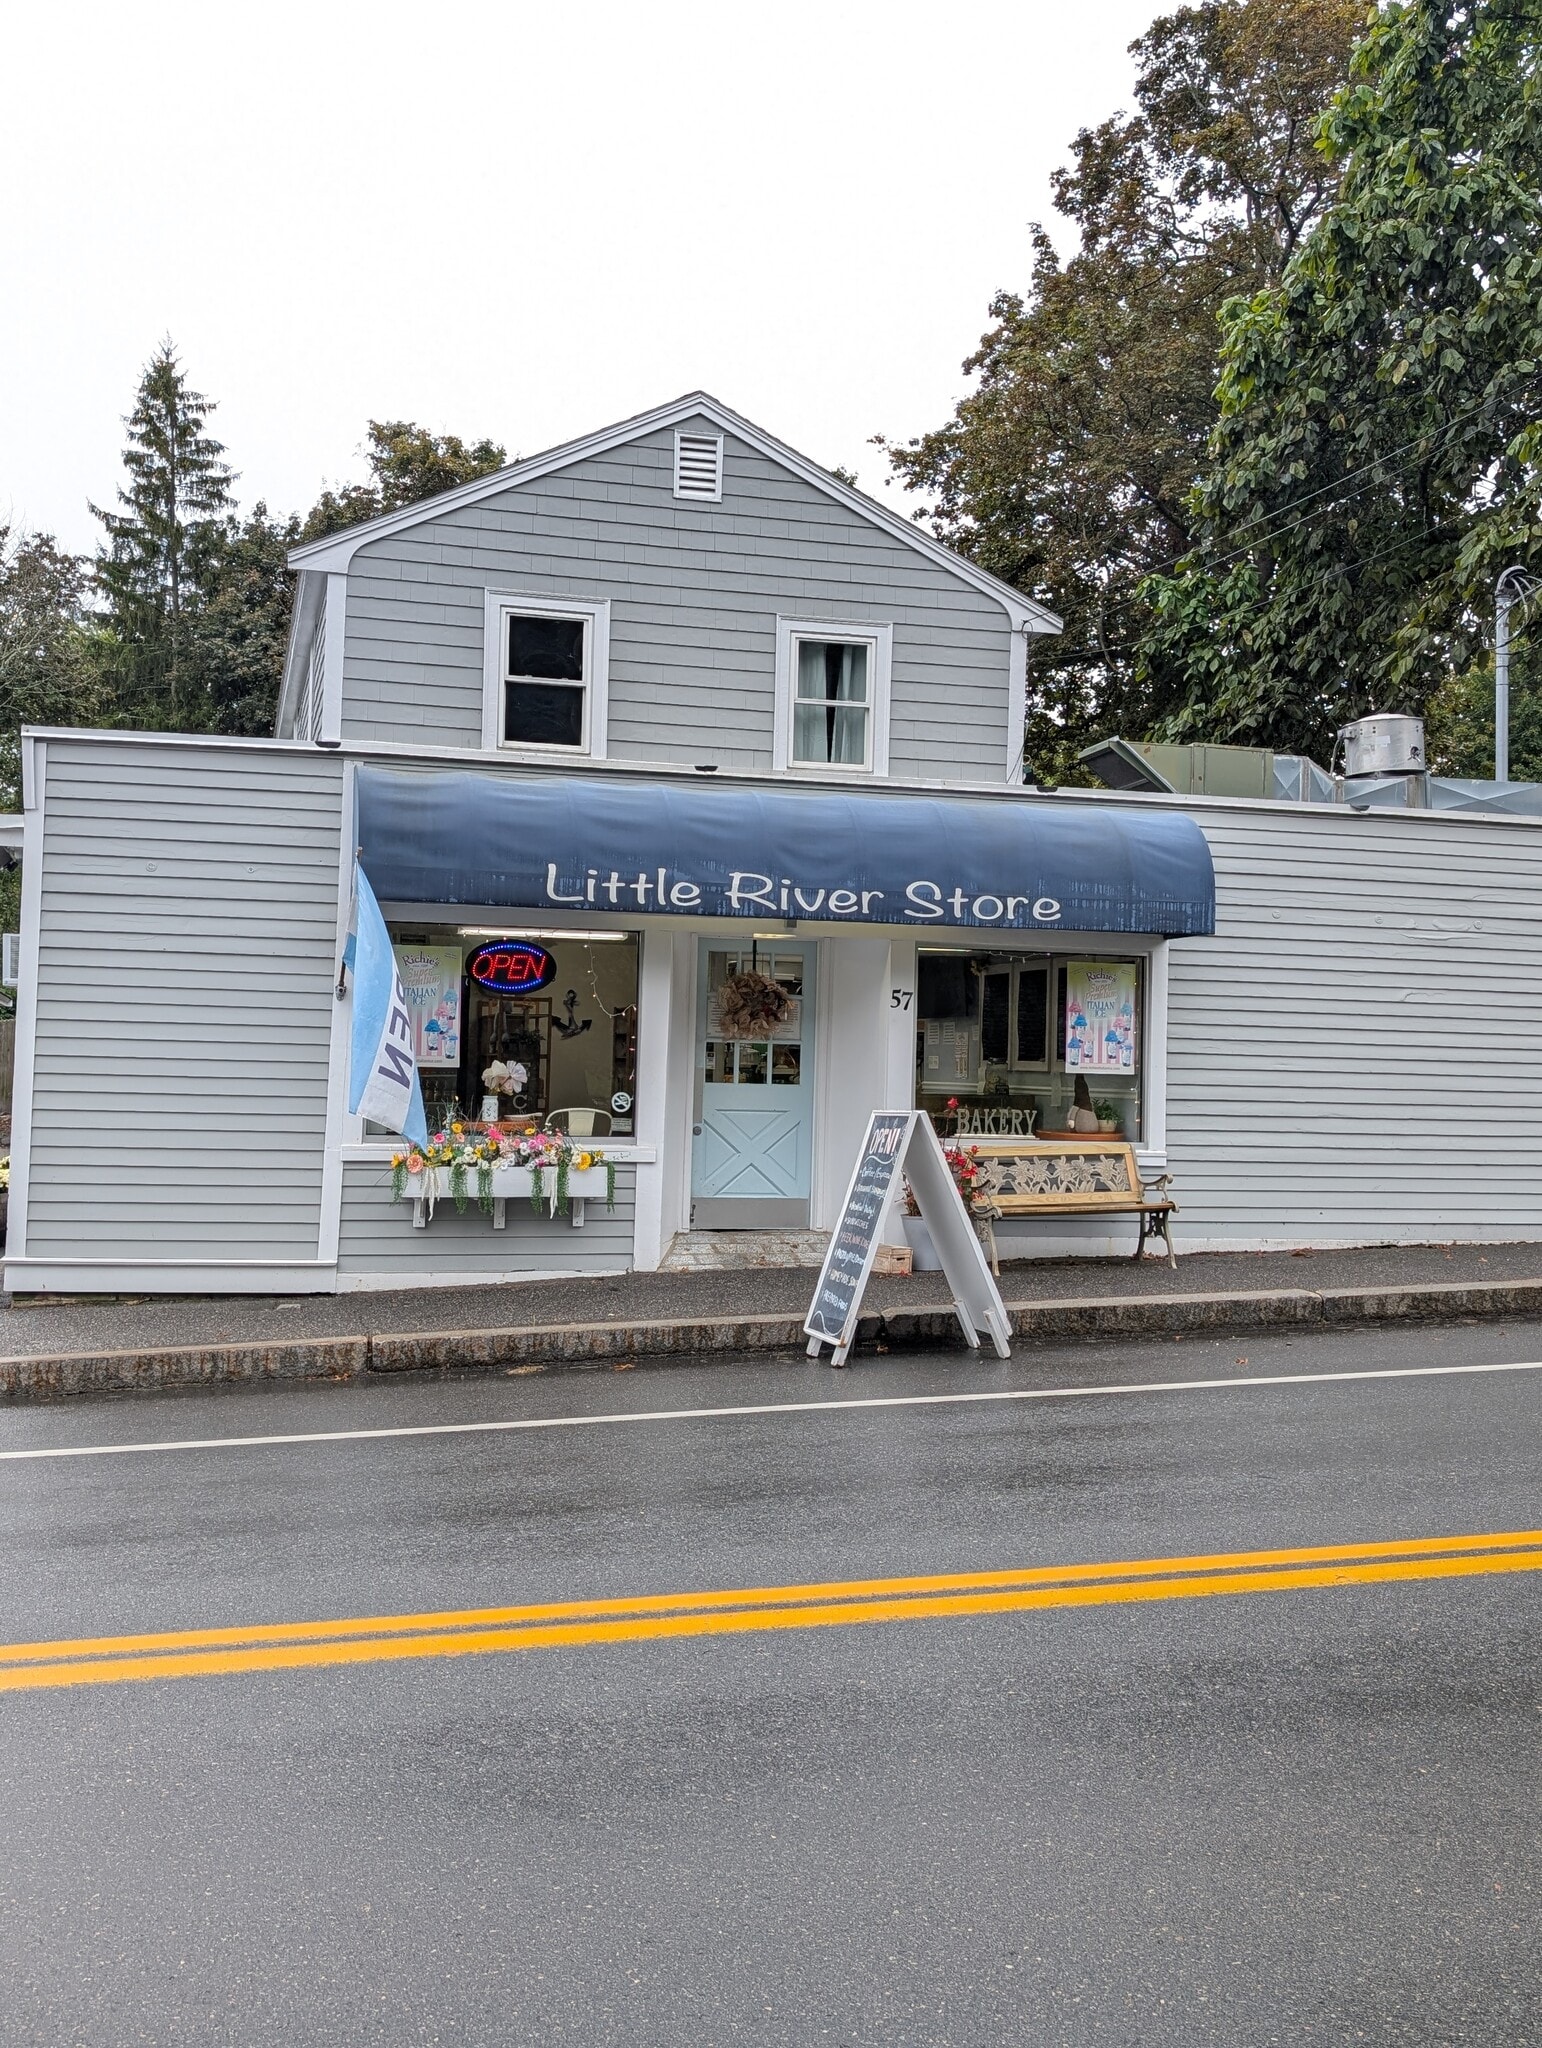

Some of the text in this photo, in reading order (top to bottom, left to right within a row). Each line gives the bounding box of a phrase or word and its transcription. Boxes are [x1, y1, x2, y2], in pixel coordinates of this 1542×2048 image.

[546, 863, 1062, 921] Little River Store
[402, 951, 440, 969] Richie's
[472, 954, 546, 979] OPEN
[890, 989, 914, 1011] 57
[956, 1108, 1037, 1136] BAKERY
[869, 1127, 902, 1156] OPEN!
